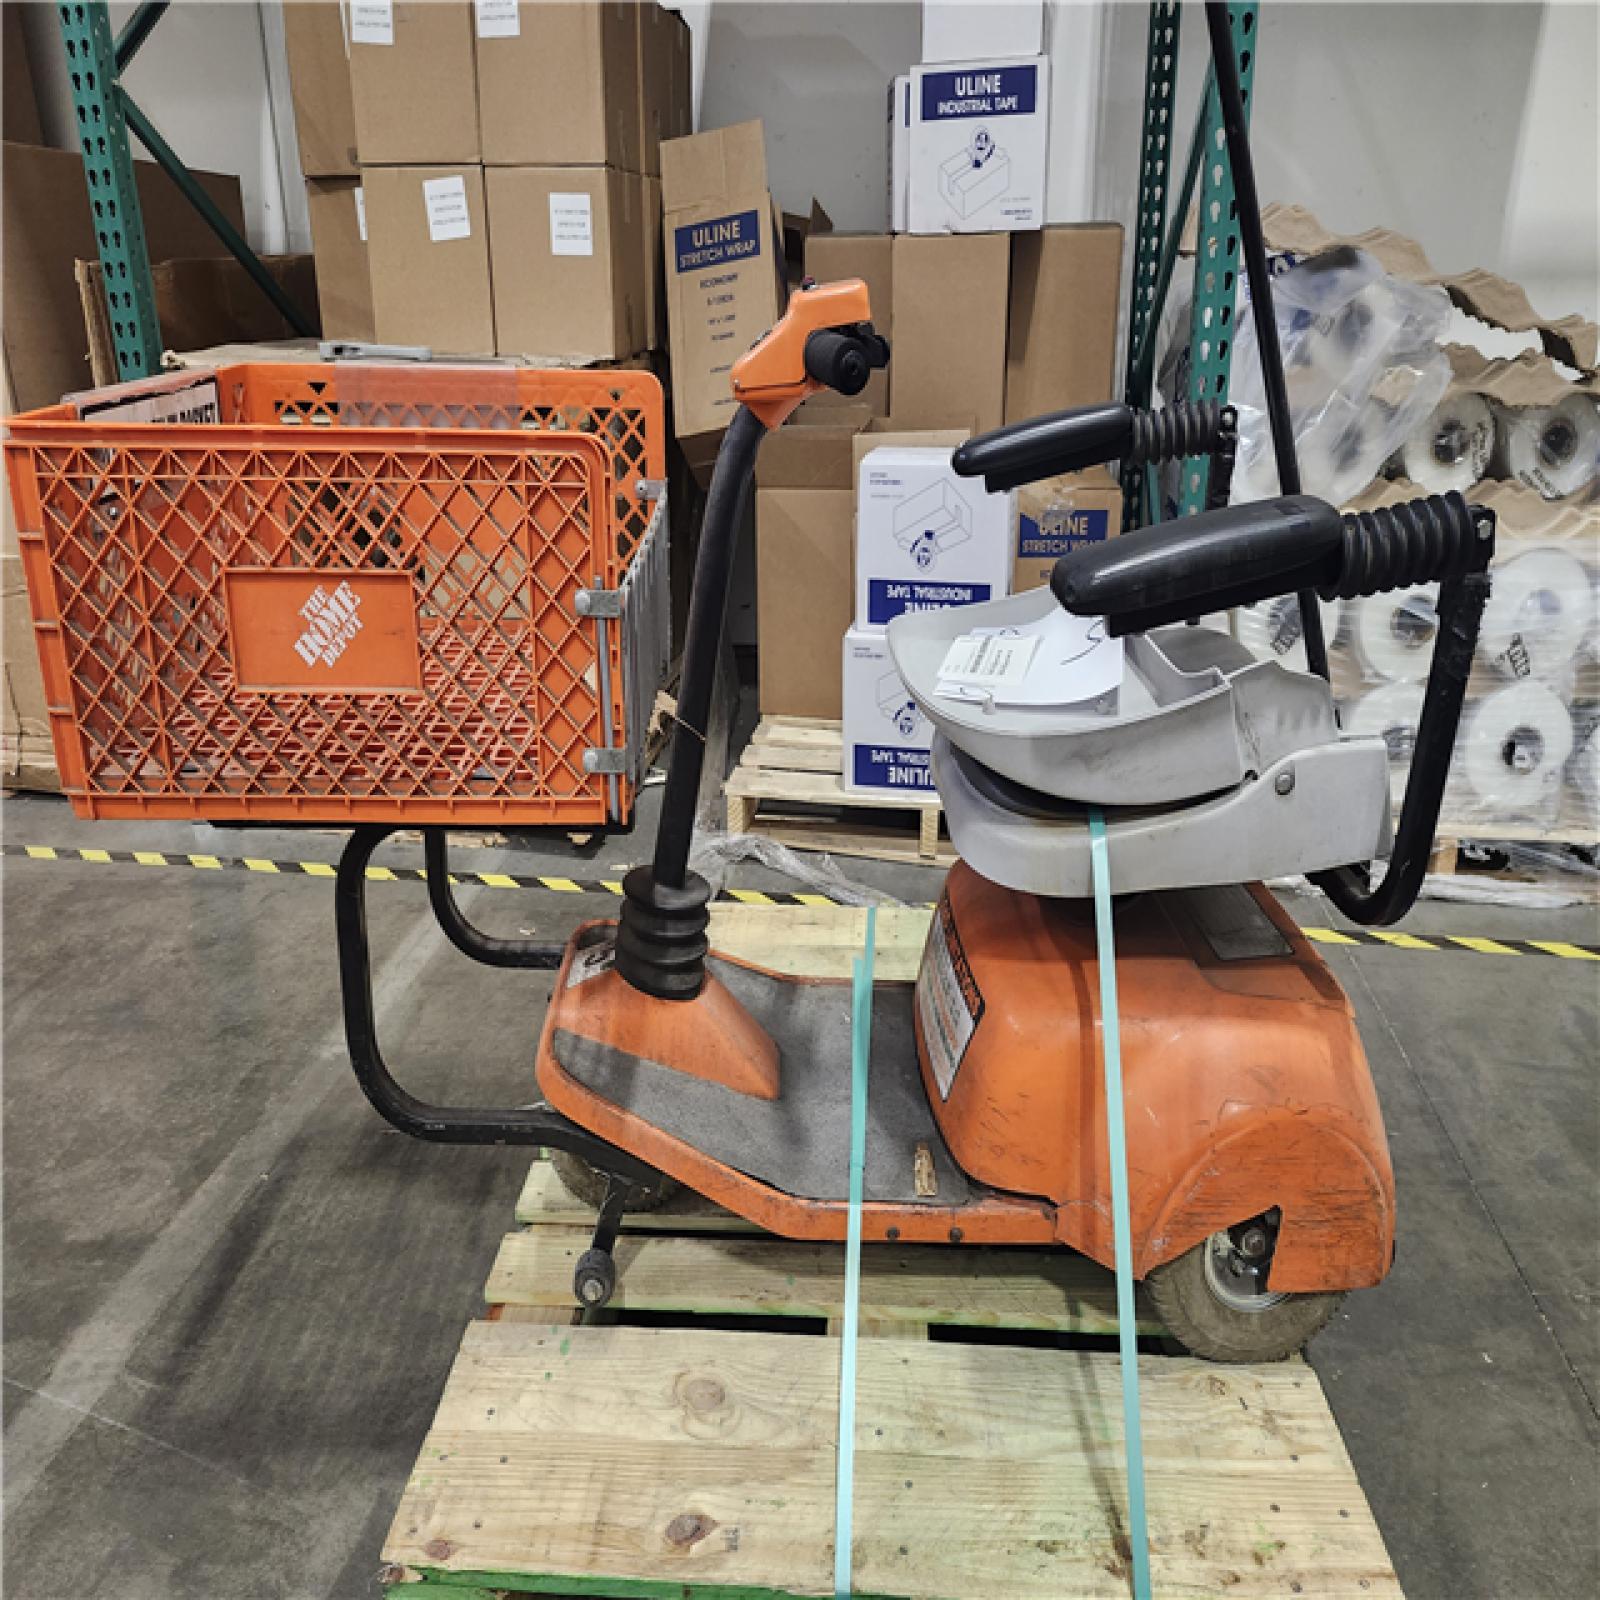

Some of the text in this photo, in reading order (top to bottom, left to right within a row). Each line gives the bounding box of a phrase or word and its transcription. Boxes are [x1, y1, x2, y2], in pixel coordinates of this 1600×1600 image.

[955, 74, 1001, 96] ULINE
[937, 95, 1018, 115] INDUSTRIAL TAPE
[692, 220, 741, 248] ULINE
[680, 239, 756, 268] STRETCH WRAP
[1023, 540, 1067, 553] STRETCH
[298, 584, 330, 621] THE
[887, 585, 972, 601] INDUSTRIAL TAPE
[293, 579, 361, 667] HOME
[321, 612, 365, 668] DEPOT
[871, 749, 932, 766] STRIAL TAPE
